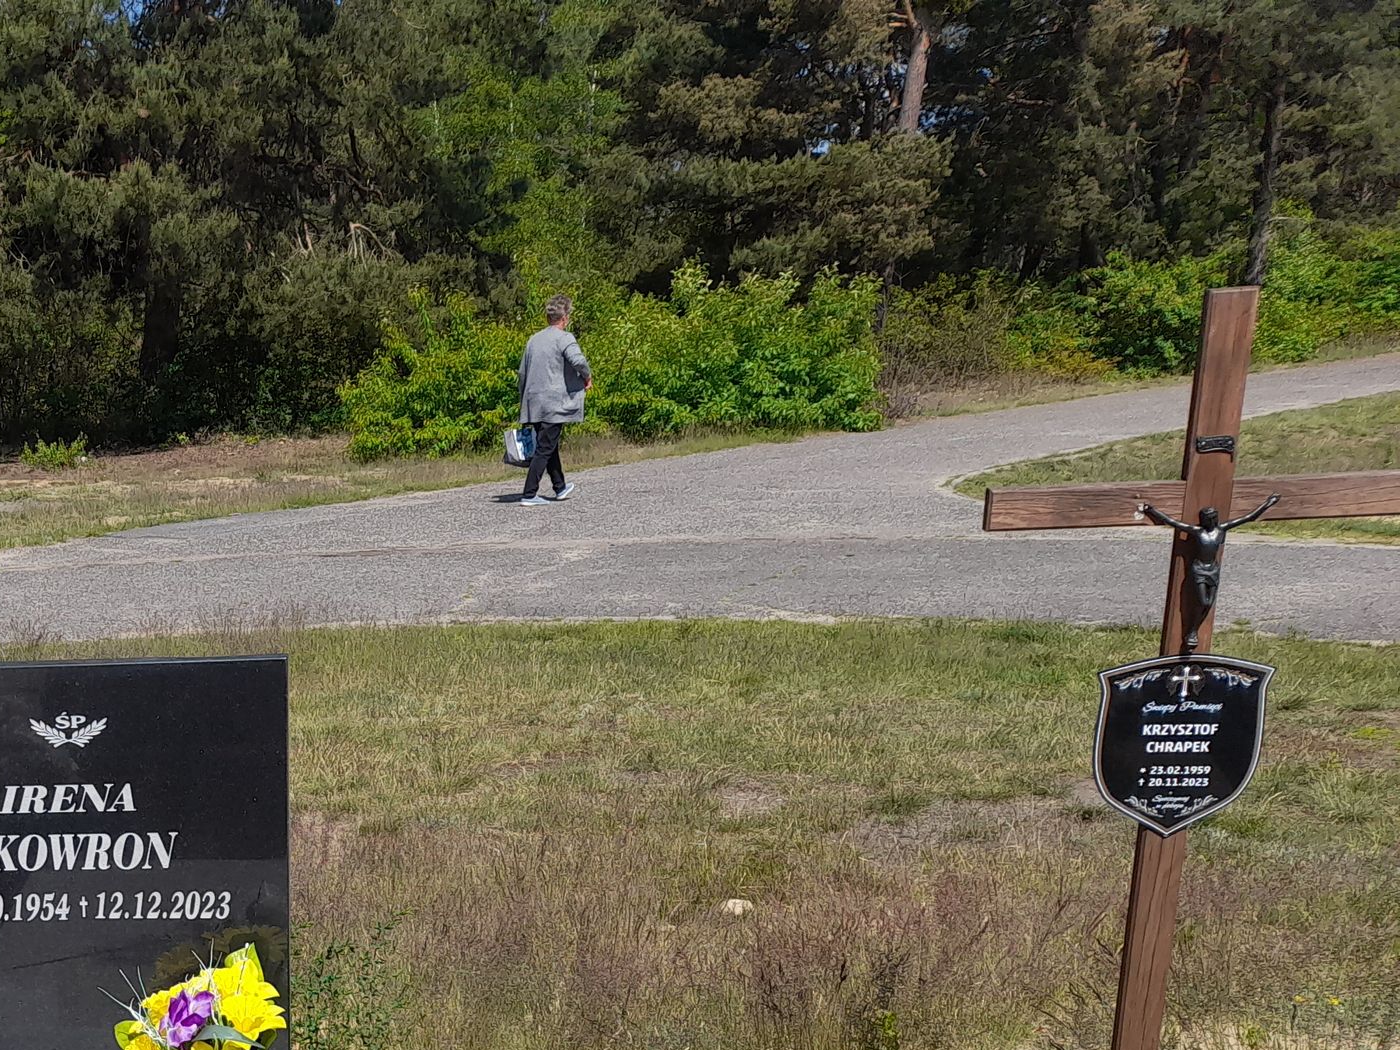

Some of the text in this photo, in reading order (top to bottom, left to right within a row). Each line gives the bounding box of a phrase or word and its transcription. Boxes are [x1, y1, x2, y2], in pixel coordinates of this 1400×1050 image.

[54, 711, 86, 730] ŚP
[1142, 723, 1220, 736] KRZYSZTOF
[1145, 741, 1211, 753] CHRAPEK
[1149, 765, 1212, 775] 23.02.1959
[1148, 777, 1209, 787] 20.11.2023
[0, 783, 137, 815] IRENA
[94, 890, 232, 921] 12.12.2023
